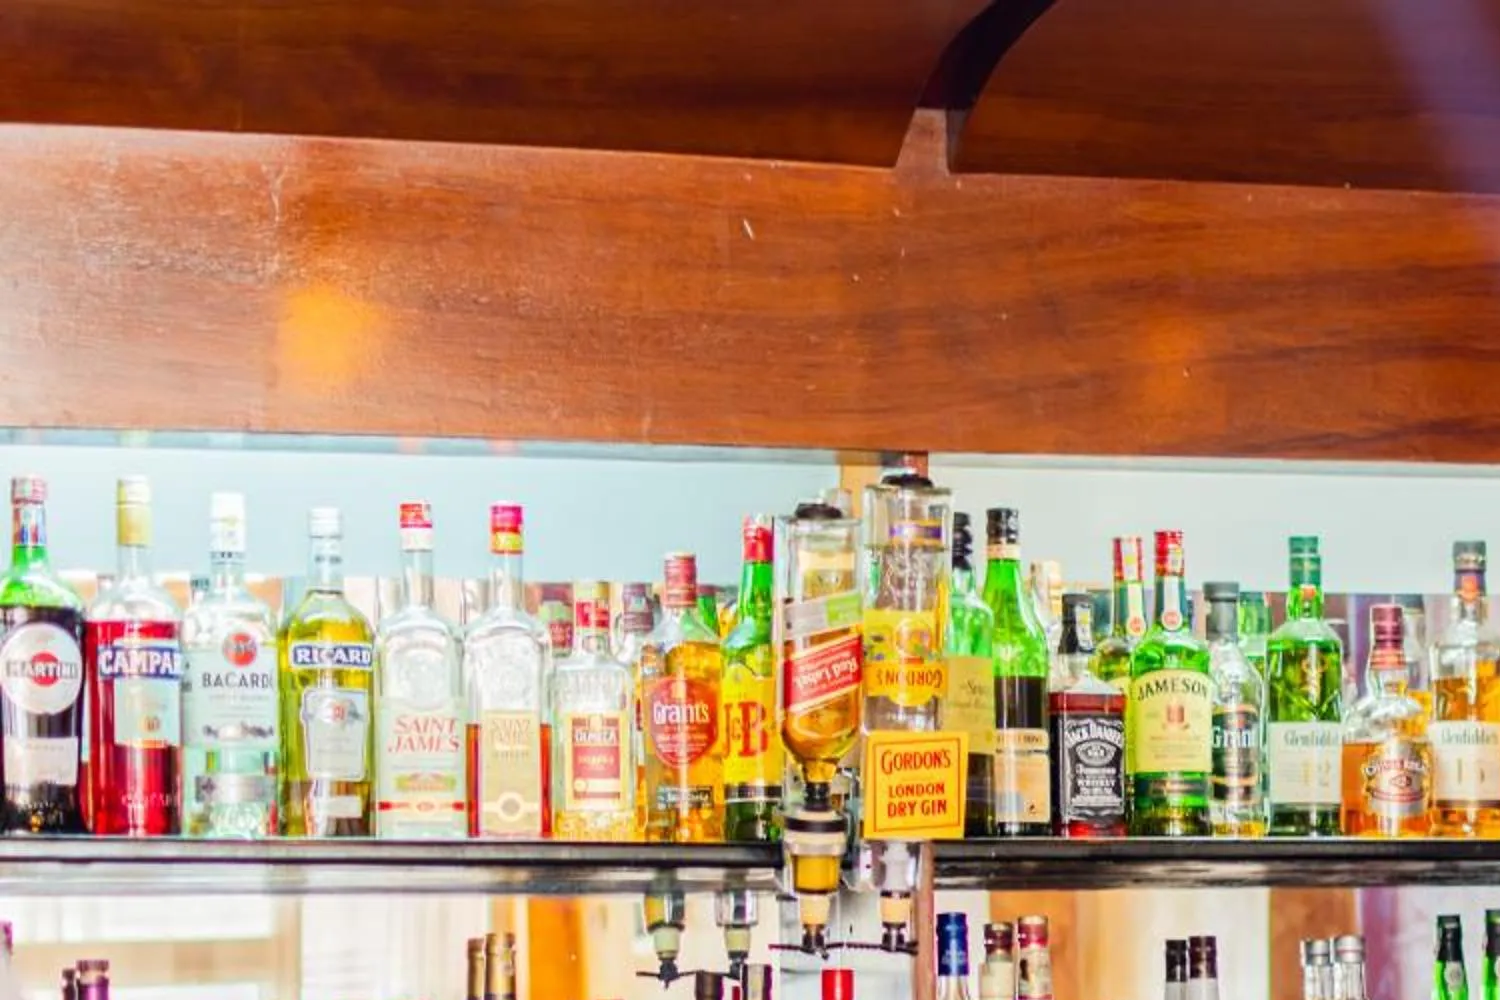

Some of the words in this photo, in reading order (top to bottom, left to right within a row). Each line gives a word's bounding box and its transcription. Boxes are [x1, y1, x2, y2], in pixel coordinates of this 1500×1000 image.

[101, 648, 183, 676] CAMPAR
[296, 646, 371, 665] RICARD
[1138, 679, 1208, 701] JAMESON
[394, 716, 458, 735] SAINT
[387, 735, 461, 754] JAMES
[881, 750, 951, 775] GORDON'S
[888, 783, 945, 798] LONDON
[887, 801, 916, 818] DRY
[921, 799, 947, 815] GIN
